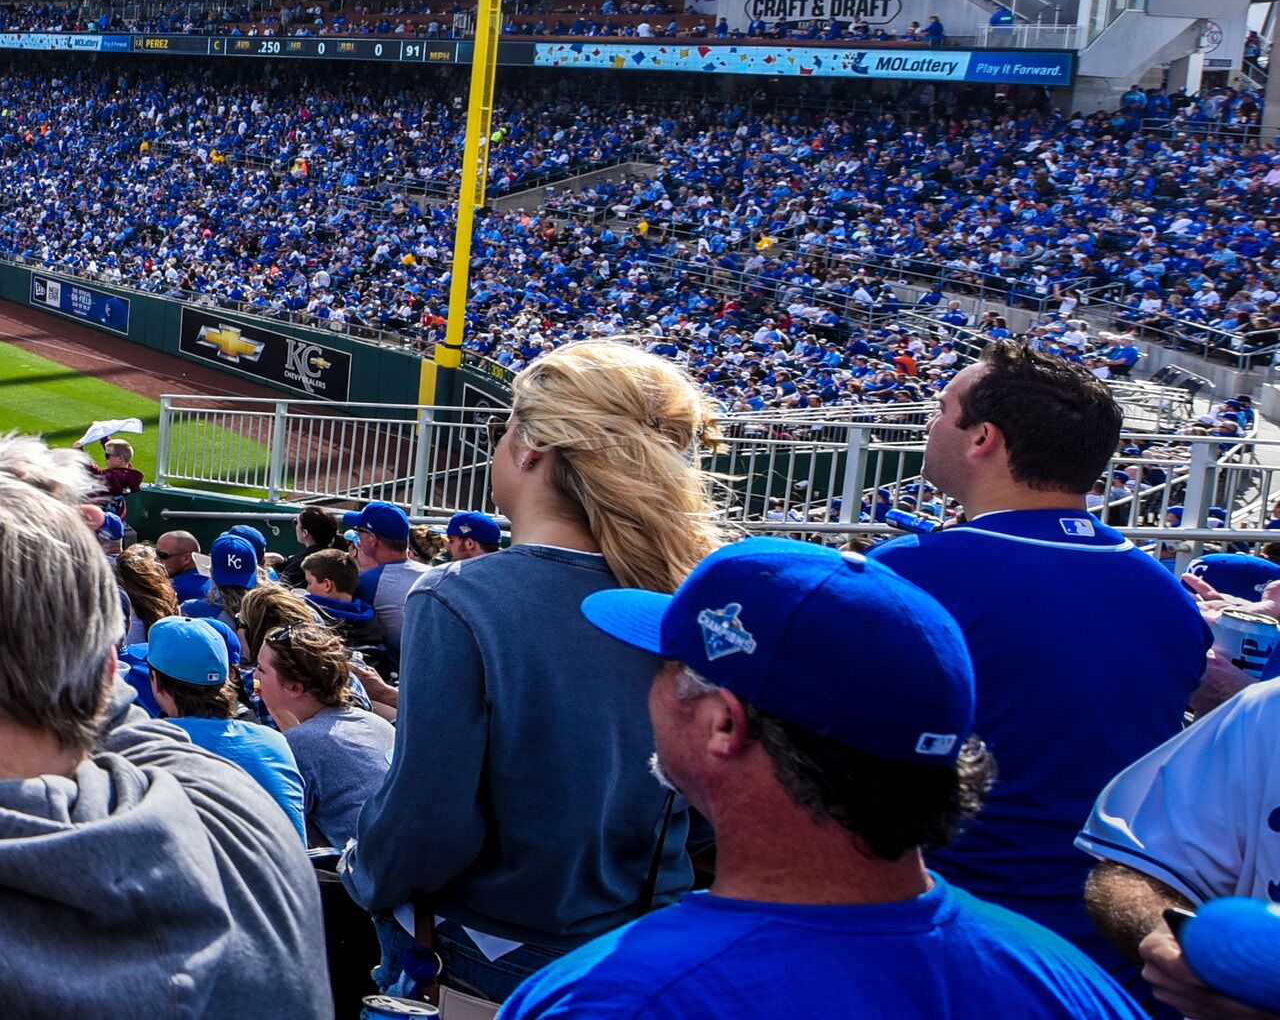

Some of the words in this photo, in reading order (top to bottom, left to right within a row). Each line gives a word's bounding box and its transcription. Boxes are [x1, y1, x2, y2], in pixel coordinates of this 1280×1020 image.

[146, 38, 168, 49] PEREZ
[213, 40, 220, 50] C
[257, 41, 281, 54] .250
[290, 41, 301, 50] HR
[317, 42, 325, 55] 0
[374, 43, 383, 57] 0
[405, 45, 420, 57] 91
[429, 51, 449, 61] MPH
[875, 57, 959, 75] MOLottery
[975, 63, 999, 75] Play
[1002, 64, 1011, 74] It
[1013, 64, 1062, 76] Forward.
[285, 339, 322, 393] KC
[491, 364, 503, 380] 330
[284, 370, 301, 381] CHEVY
[228, 553, 242, 570] KC
